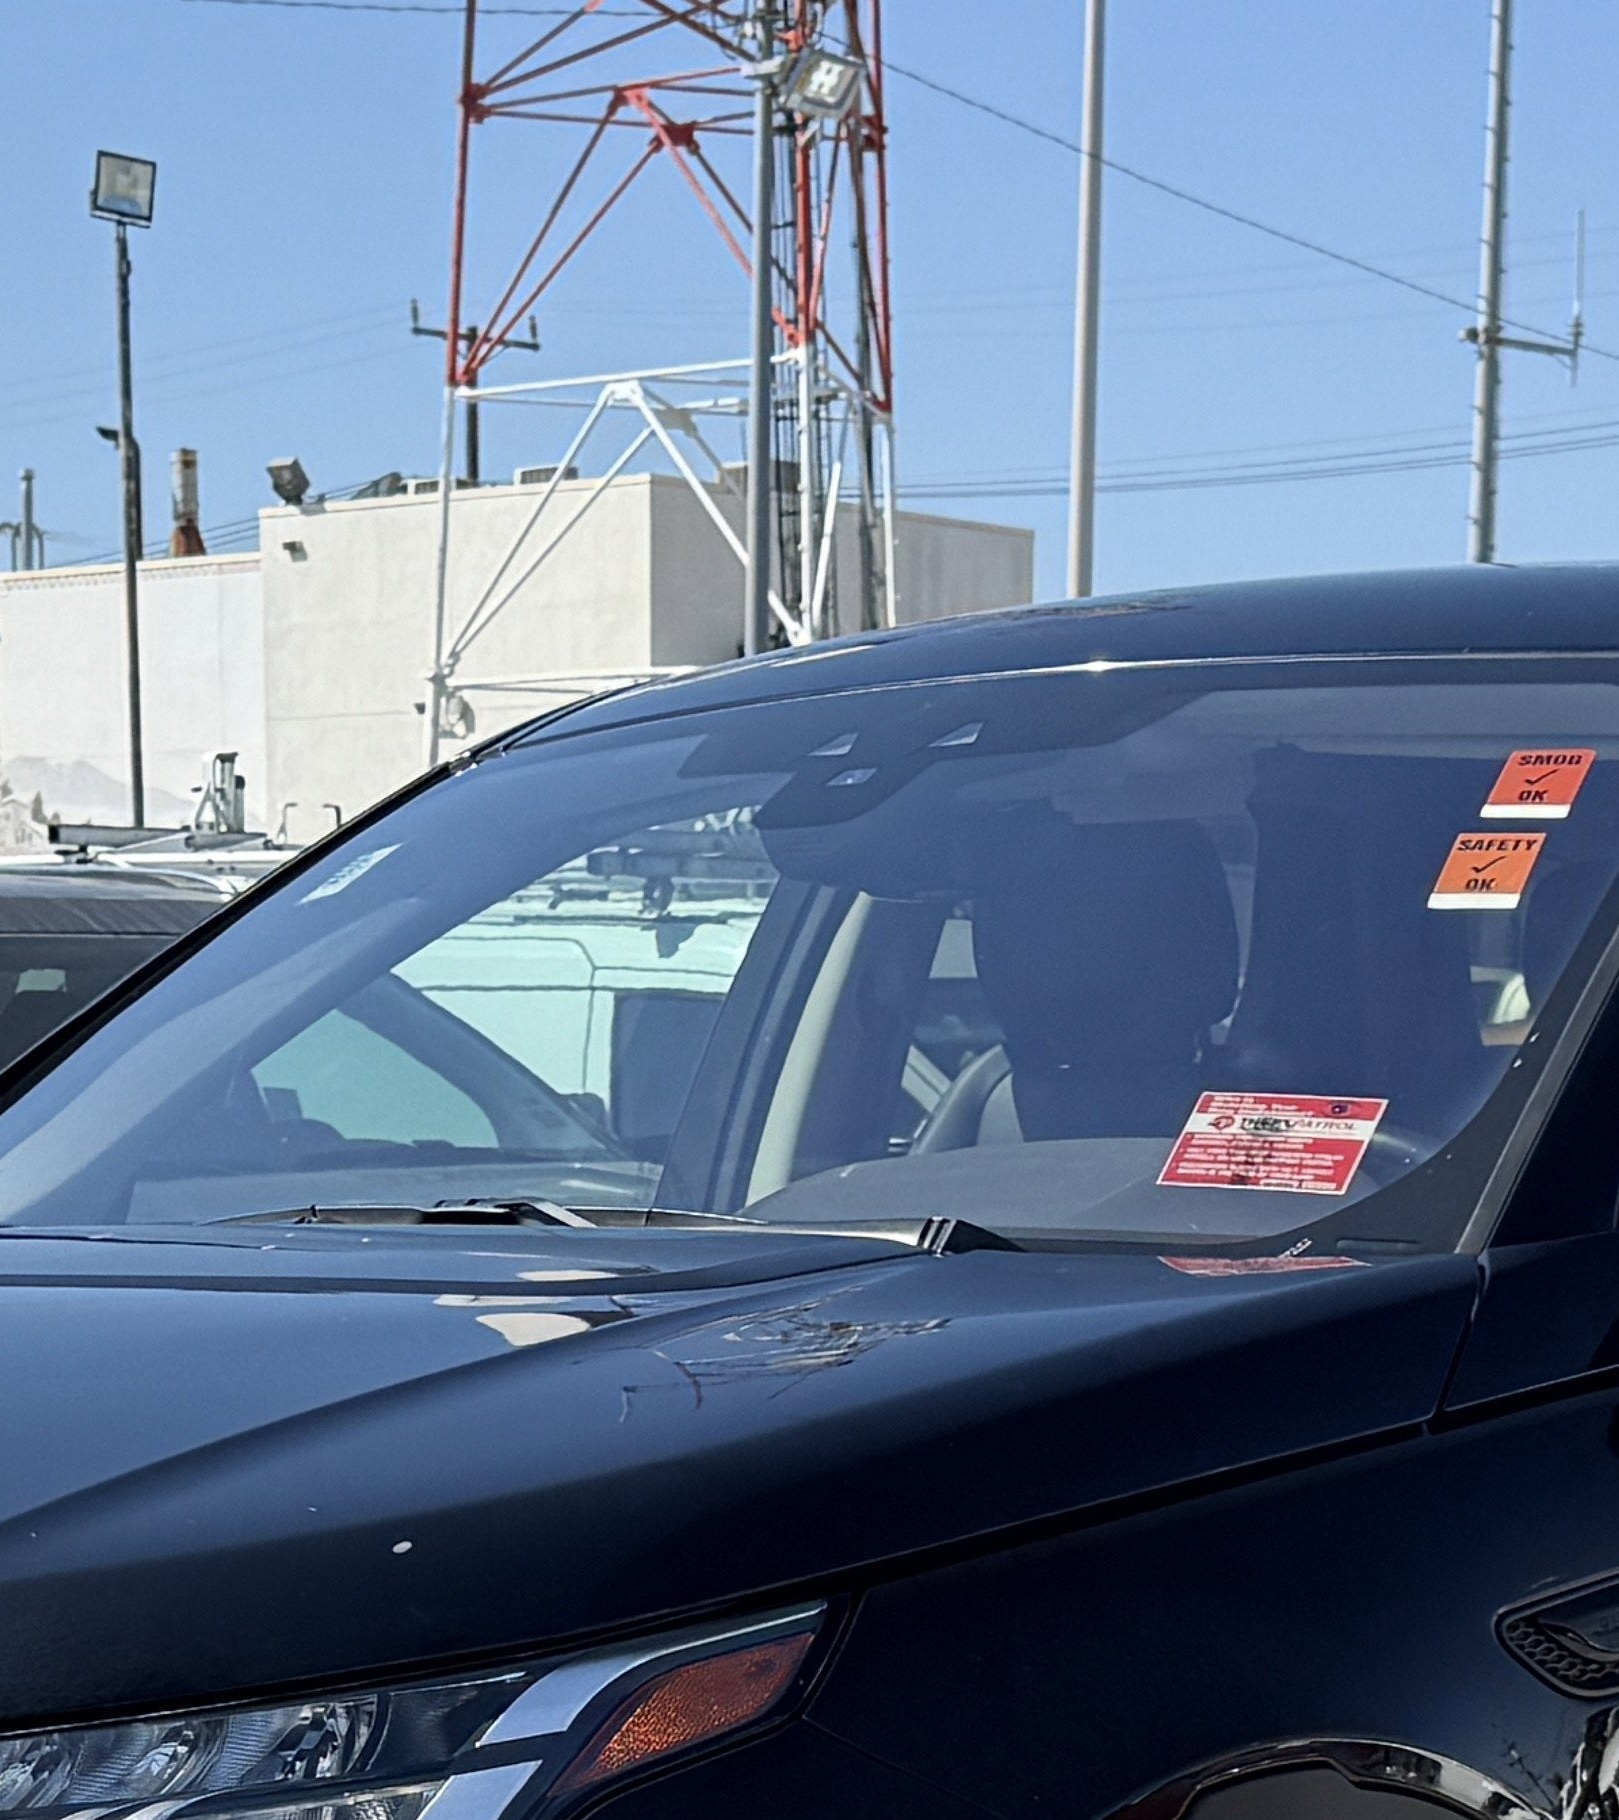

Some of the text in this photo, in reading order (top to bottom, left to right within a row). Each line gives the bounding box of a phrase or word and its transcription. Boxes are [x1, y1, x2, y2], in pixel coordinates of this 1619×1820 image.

[1518, 790, 1548, 801] OK
[1457, 839, 1537, 851] SAFETY
[1465, 878, 1496, 891] OK
